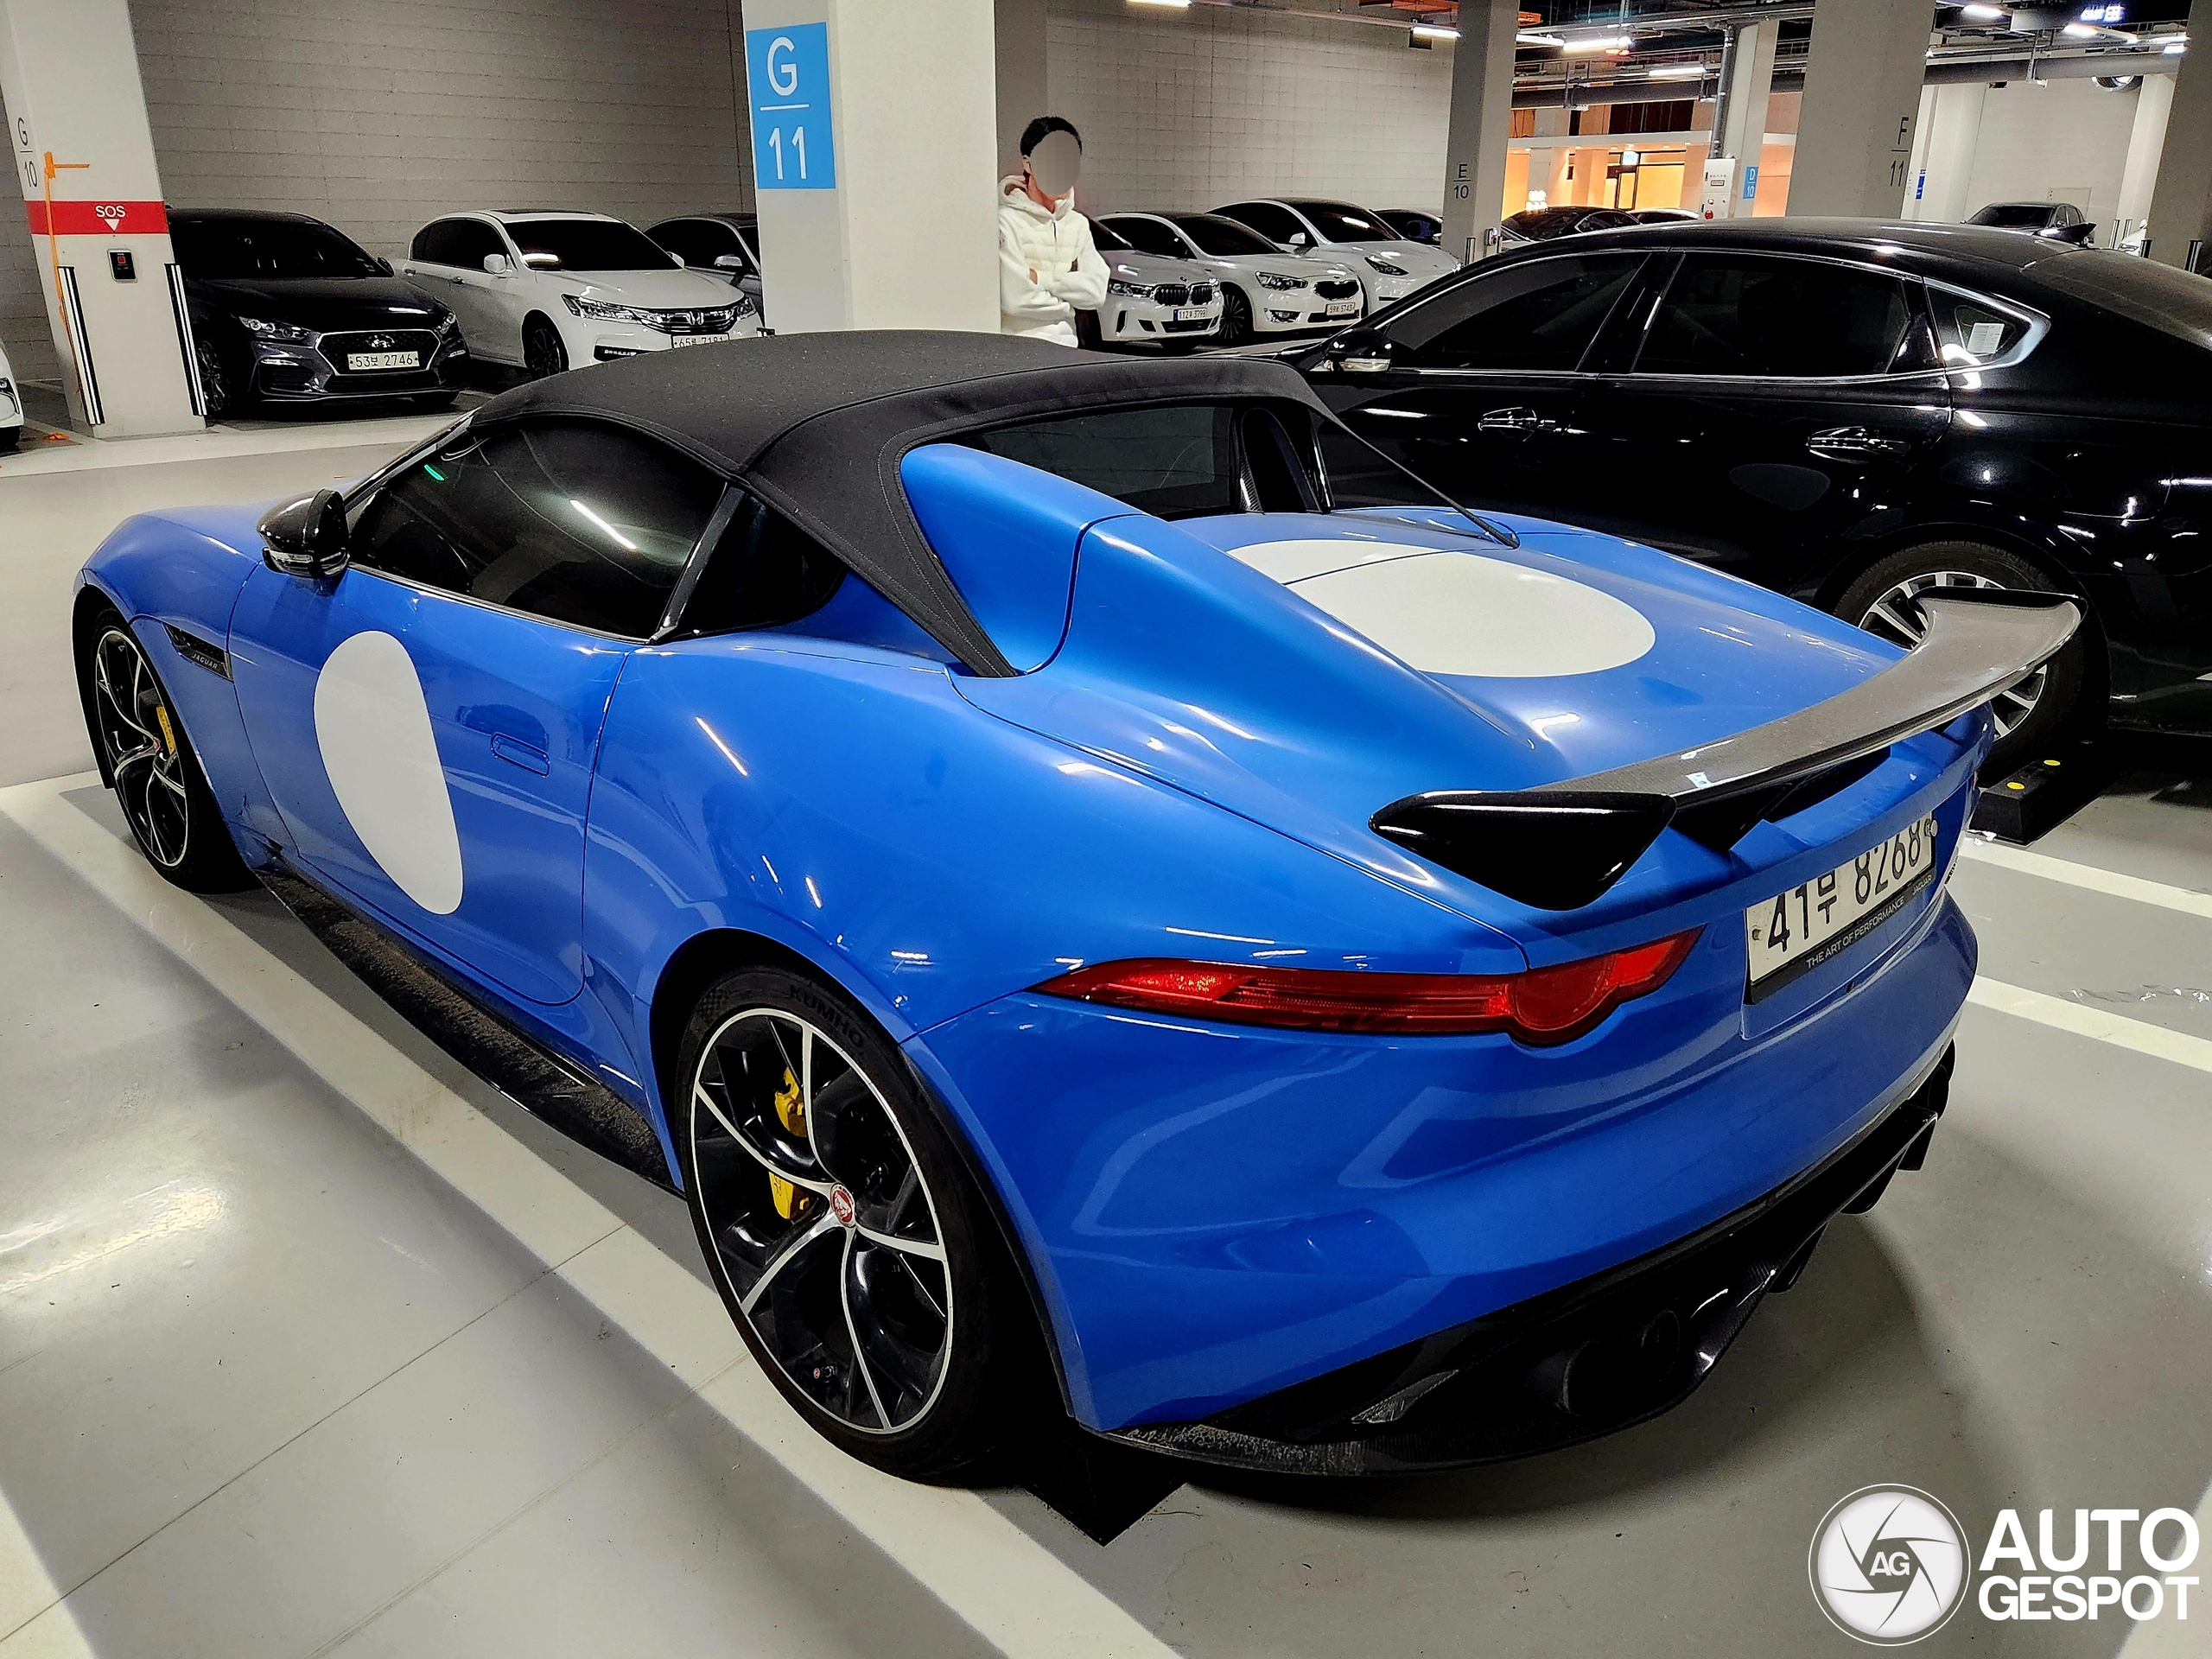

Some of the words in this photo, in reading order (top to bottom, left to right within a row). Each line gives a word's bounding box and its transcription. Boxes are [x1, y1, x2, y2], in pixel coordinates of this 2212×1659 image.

[767, 36, 798, 96] G
[18, 117, 29, 146] G
[1897, 117, 1909, 144] F
[768, 126, 807, 180] 11
[24, 161, 37, 188] 10
[1459, 163, 1468, 178] E
[1749, 168, 1756, 181] D
[1891, 160, 1904, 187] 11
[1454, 185, 1469, 199] 10
[95, 205, 126, 218] SOS
[355, 356, 378, 367] 53보
[384, 354, 413, 365] 2746
[192, 653, 218, 670] JAGUAR
[1854, 820, 1921, 905] 8268
[1806, 953, 1825, 969] THE
[1824, 940, 1842, 962] ART
[1842, 932, 1854, 948] OF
[1854, 895, 1905, 940] PERFORMANCE
[1912, 874, 1932, 896] JAGUAR
[790, 985, 864, 1048] KUMHO
